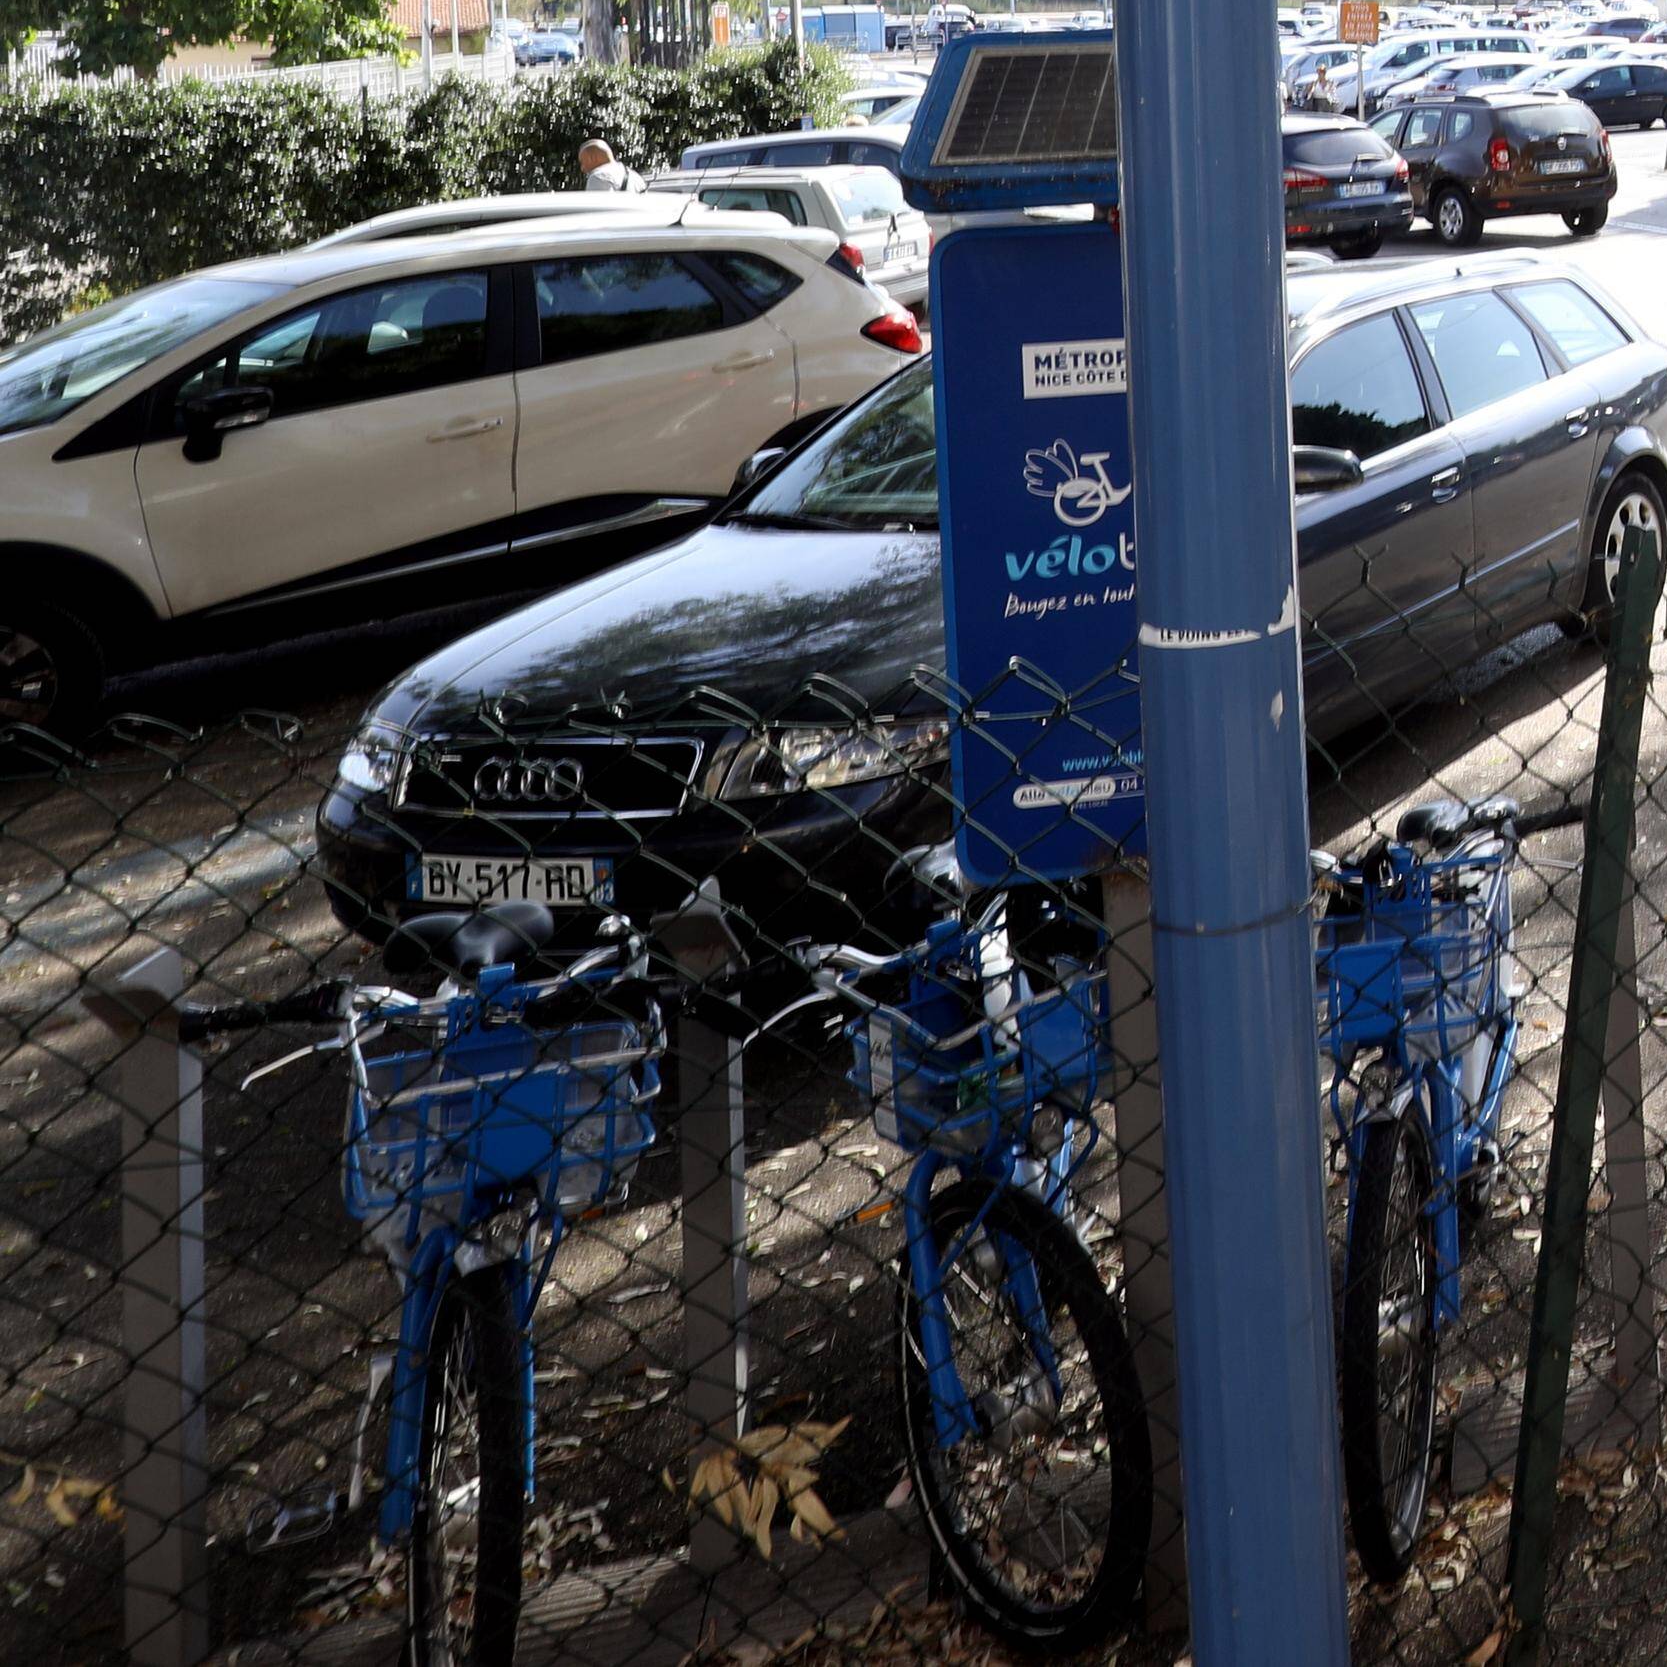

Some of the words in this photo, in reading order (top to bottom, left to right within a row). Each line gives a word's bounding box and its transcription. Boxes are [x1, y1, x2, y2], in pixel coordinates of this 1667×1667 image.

[1035, 372, 1071, 387] NICE
[1076, 369, 1116, 385] CÔTE
[1004, 591, 1066, 621] Bougez
[1073, 593, 1095, 607] en
